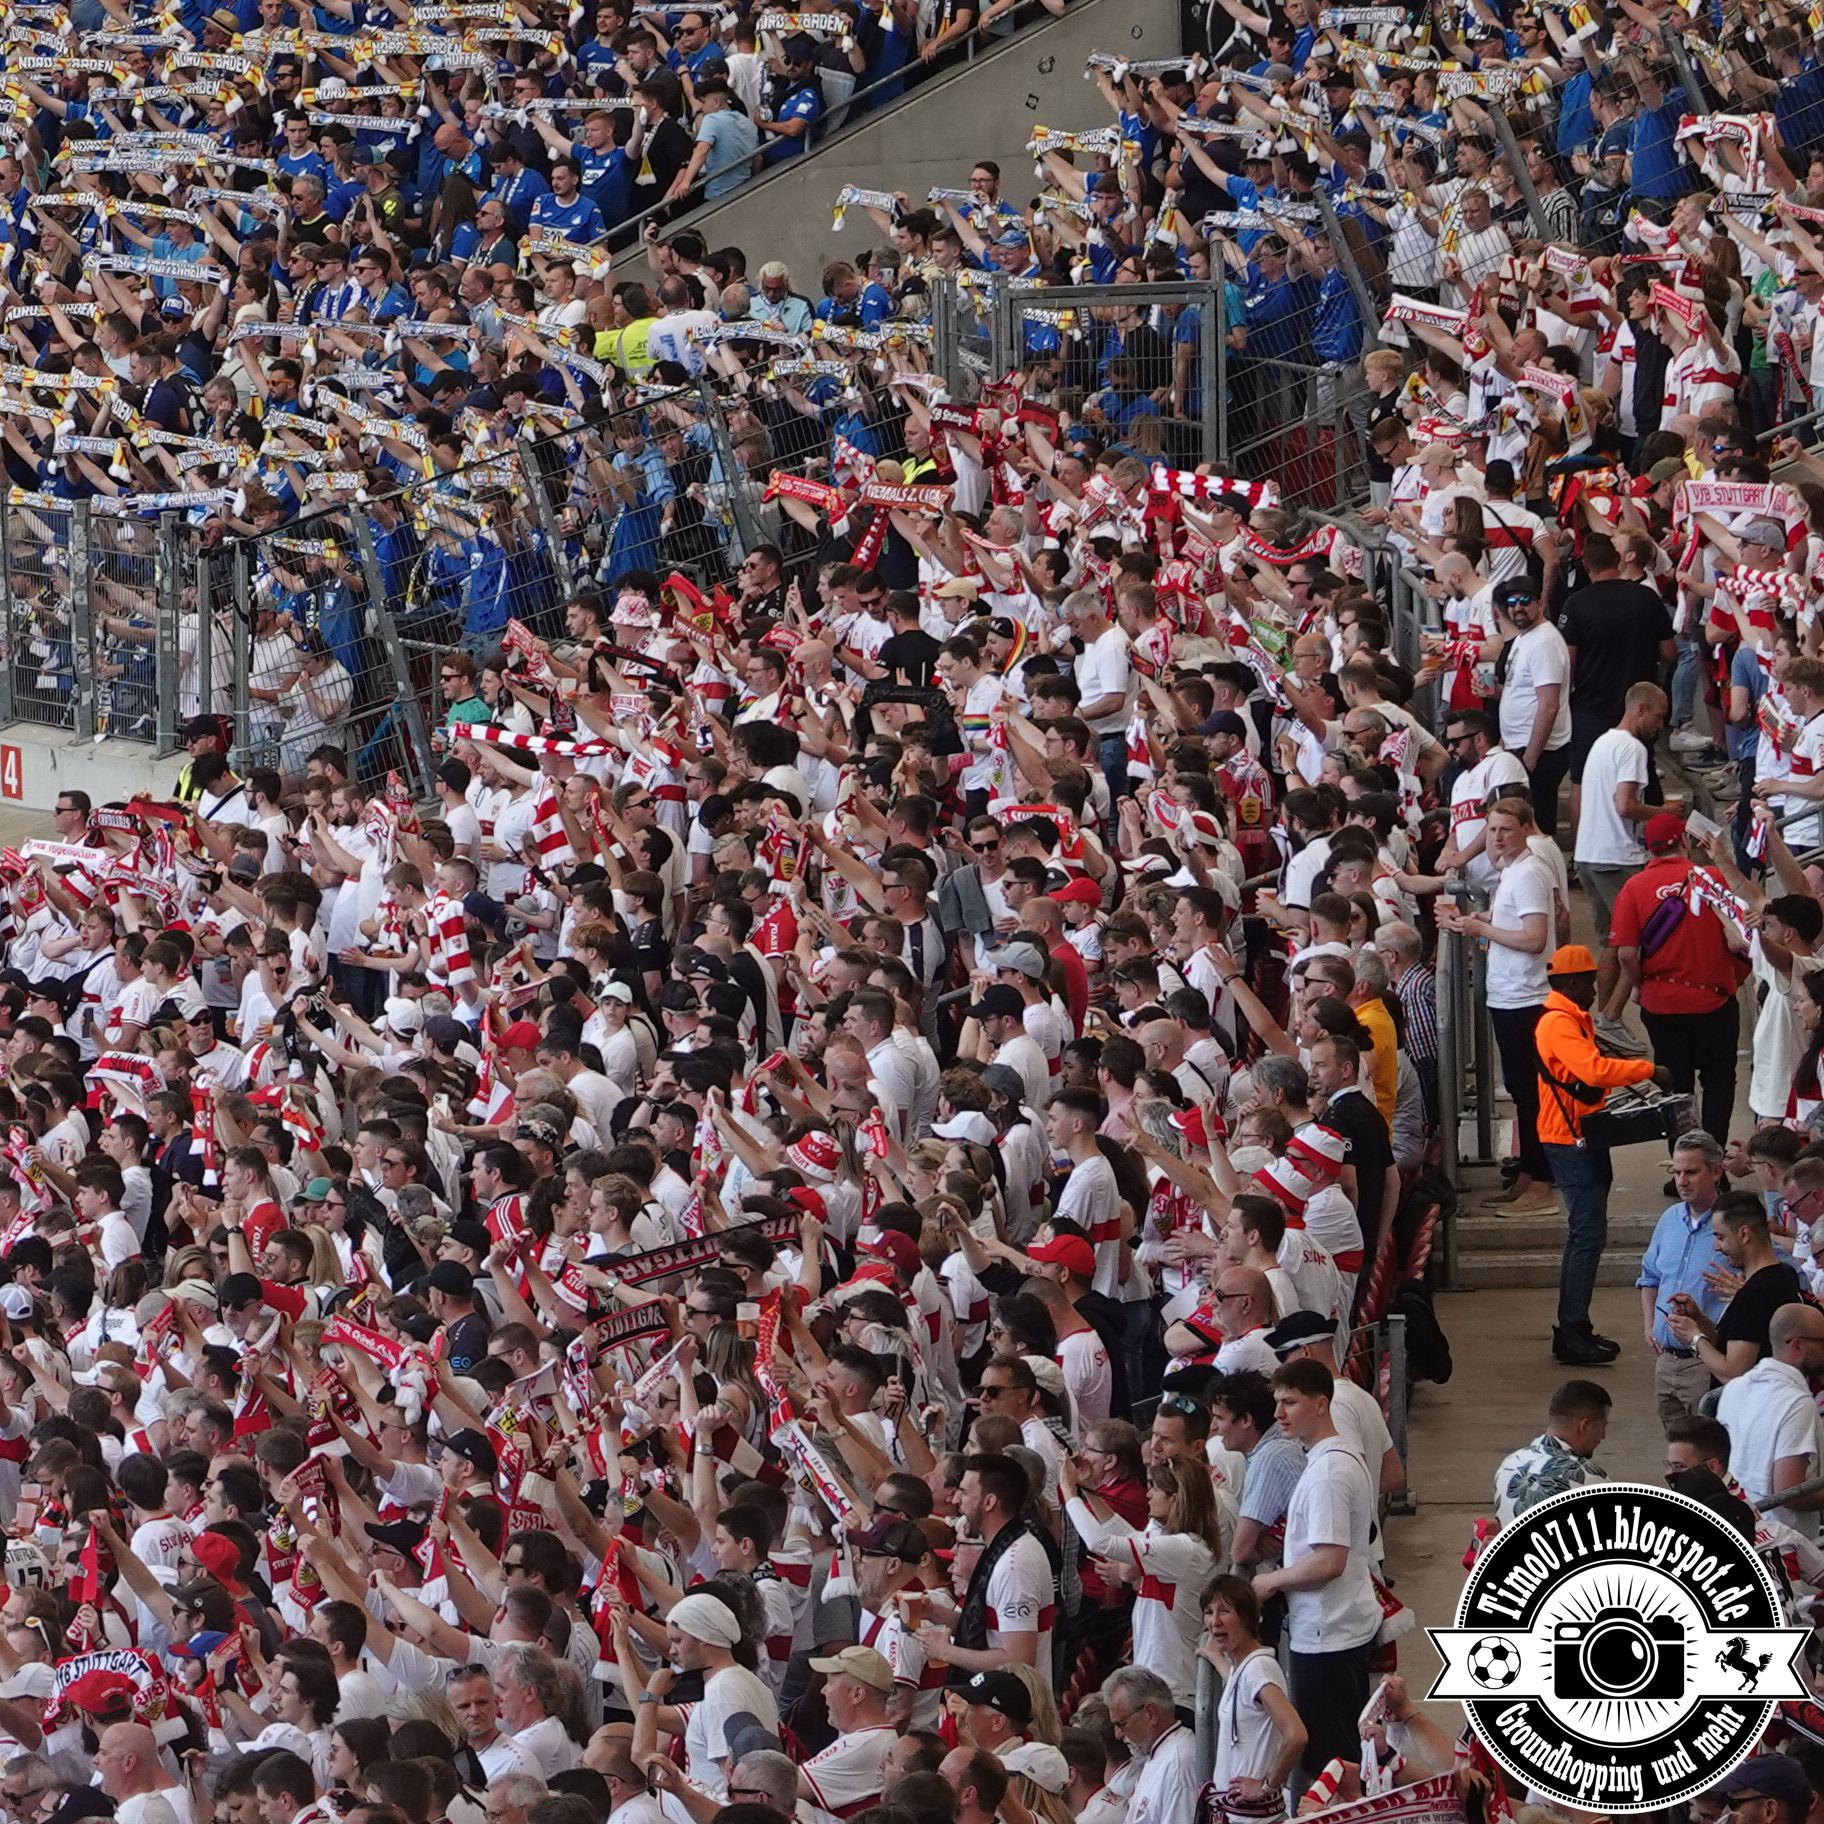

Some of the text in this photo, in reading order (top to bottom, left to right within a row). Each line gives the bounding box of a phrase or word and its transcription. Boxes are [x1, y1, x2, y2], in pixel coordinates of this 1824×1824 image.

[19, 56, 112, 71] NORD BADEN
[4, 750, 19, 795] 4
